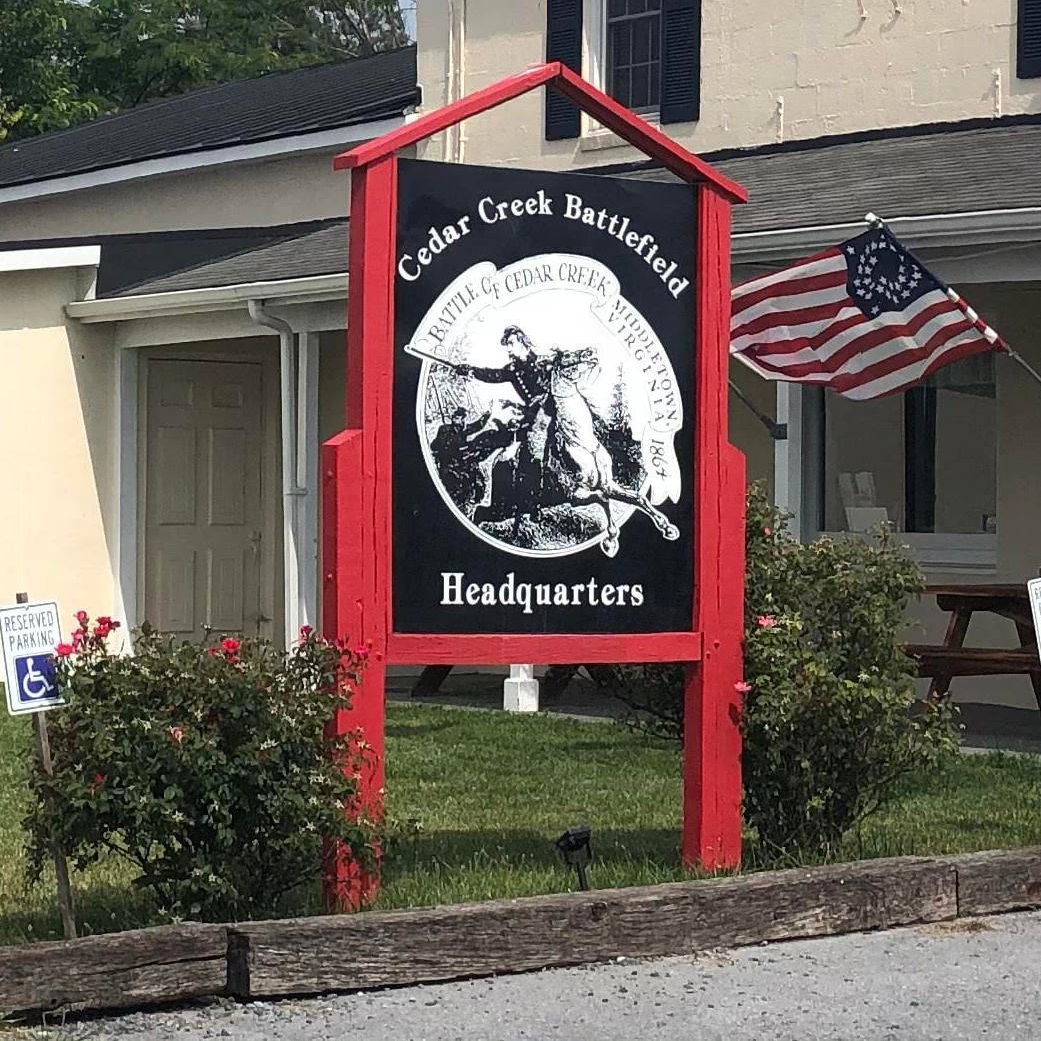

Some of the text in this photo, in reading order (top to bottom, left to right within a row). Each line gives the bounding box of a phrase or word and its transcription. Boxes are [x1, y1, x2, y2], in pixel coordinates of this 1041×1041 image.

[398, 189, 690, 300] Cedar Creek Battlefield
[427, 262, 612, 343] BATTLE OF CEDAR CREEK
[608, 312, 665, 422] VIRGINIA
[649, 438, 669, 481] 1864
[440, 572, 644, 614] Headquarters
[4, 610, 54, 632] RESERVED
[9, 629, 55, 652] PARKING
